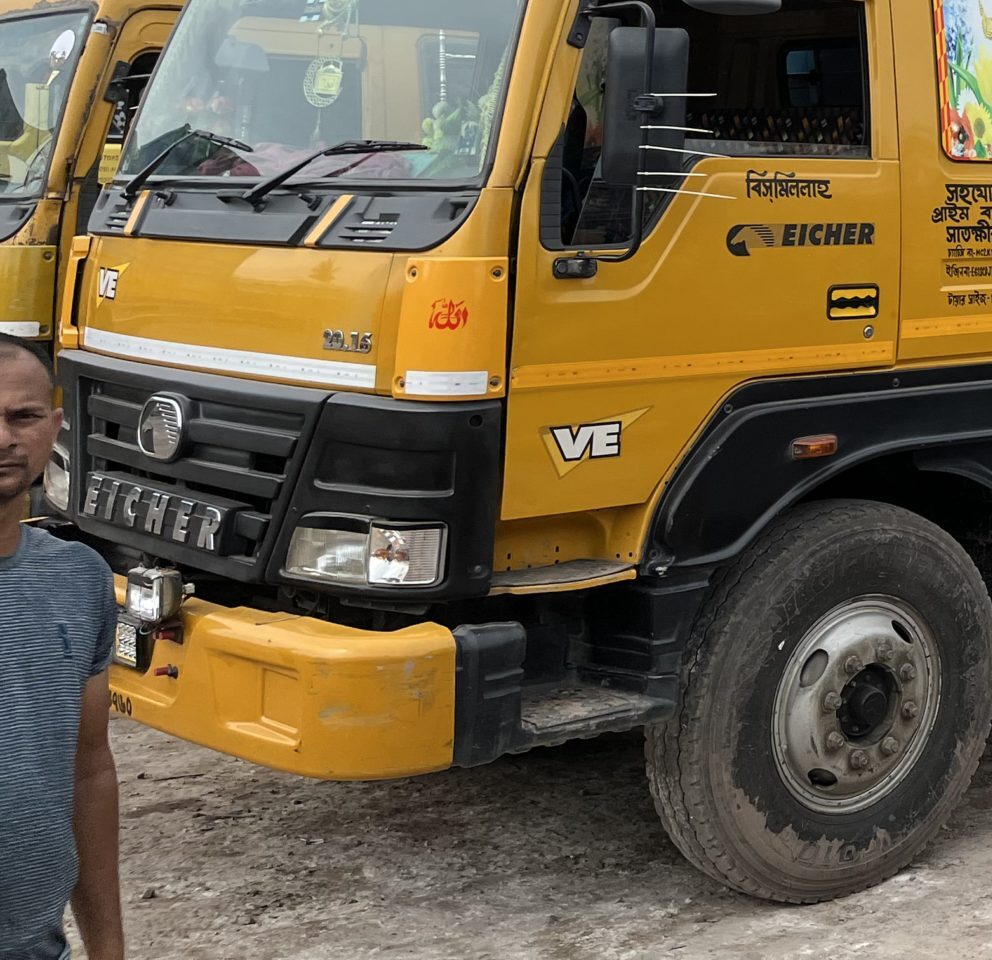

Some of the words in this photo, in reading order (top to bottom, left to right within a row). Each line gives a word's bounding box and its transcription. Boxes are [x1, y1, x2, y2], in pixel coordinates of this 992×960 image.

[931, 200, 970, 223] প্রাইম
[782, 223, 875, 247] EICHER
[99, 266, 119, 300] VE
[549, 421, 622, 462] VE
[83, 476, 222, 551] EICHER
